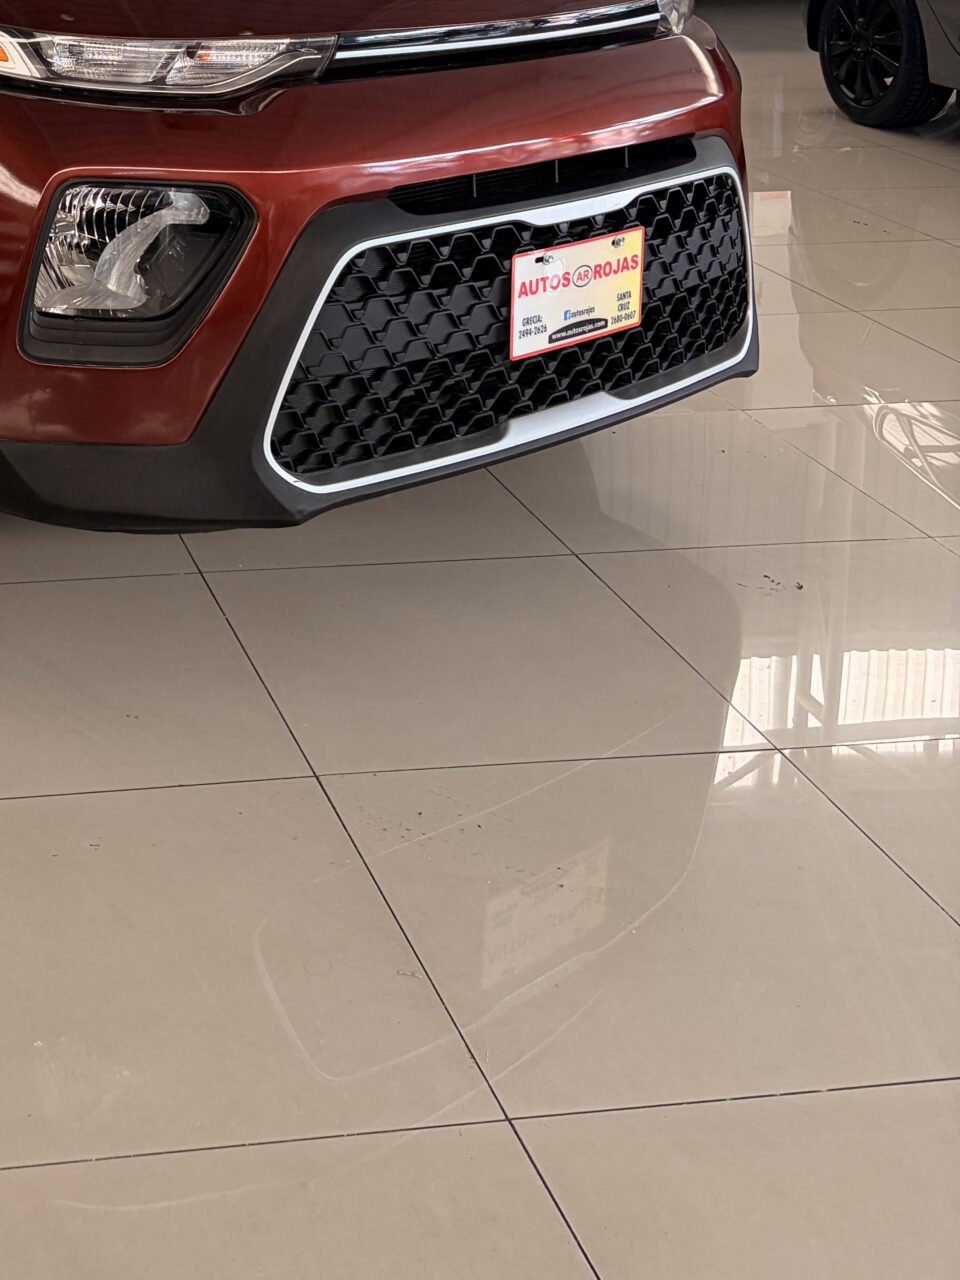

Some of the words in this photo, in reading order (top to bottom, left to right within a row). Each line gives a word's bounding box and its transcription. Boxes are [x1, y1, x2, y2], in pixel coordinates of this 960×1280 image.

[517, 271, 571, 298] AUTOS
[575, 269, 590, 283] AR
[593, 254, 639, 280] ROJAS
[616, 290, 632, 302] SANTA
[617, 301, 631, 313] CRUZ
[551, 320, 606, 340] www.autosrojas.com
